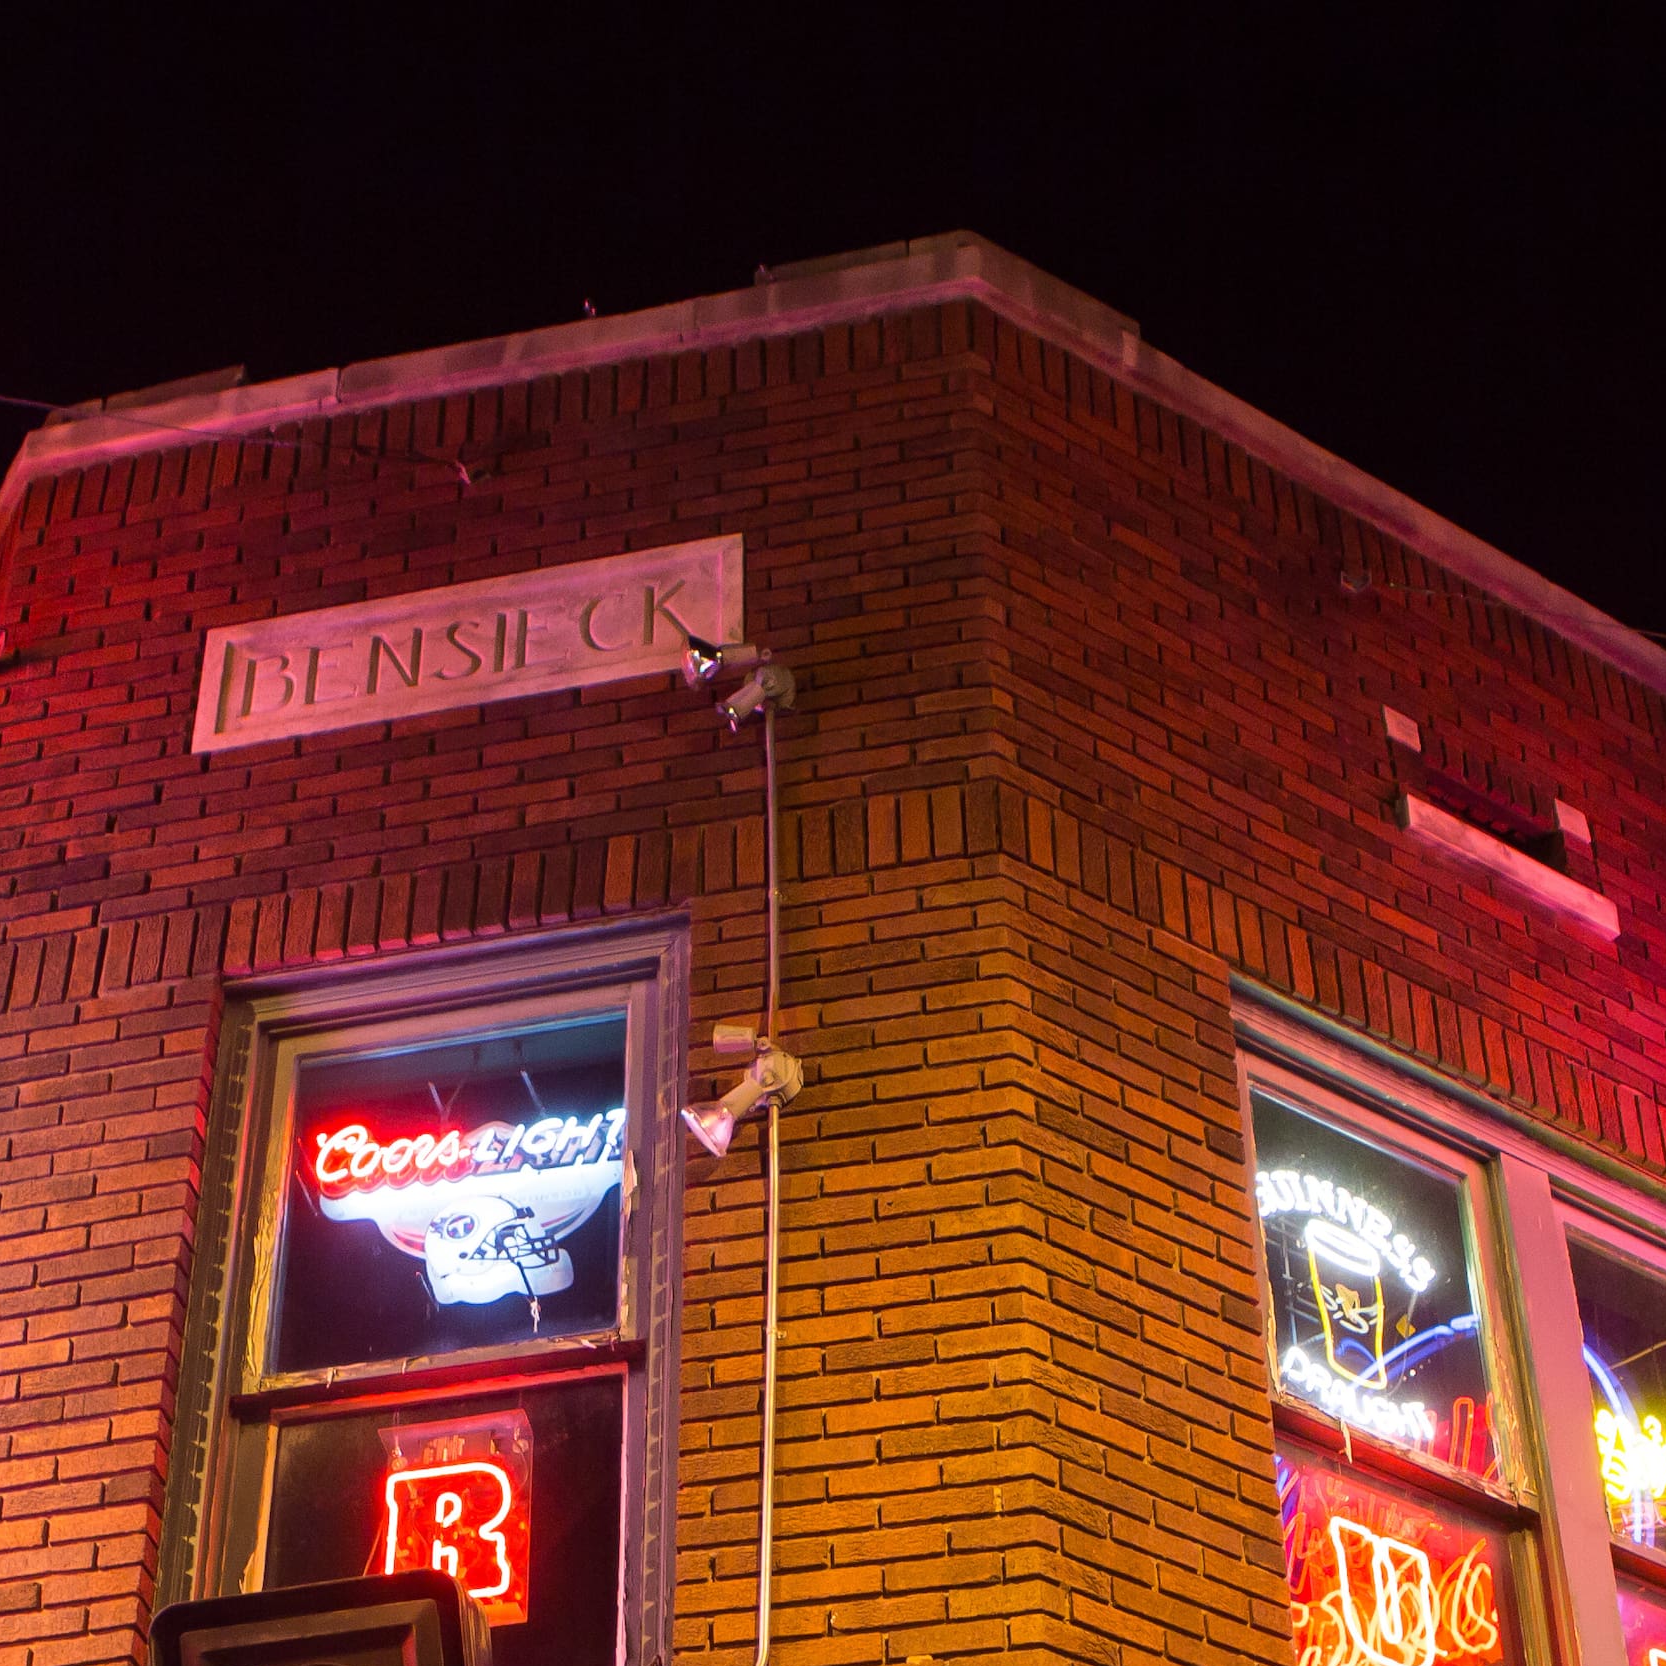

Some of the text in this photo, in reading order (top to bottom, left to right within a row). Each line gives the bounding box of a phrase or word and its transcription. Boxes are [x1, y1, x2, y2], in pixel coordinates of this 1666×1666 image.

[239, 578, 693, 719] BENSIECK
[316, 1122, 471, 1198] Coors
[1279, 1345, 1437, 1442] DRAUGHT
[384, 1461, 512, 1599] R
